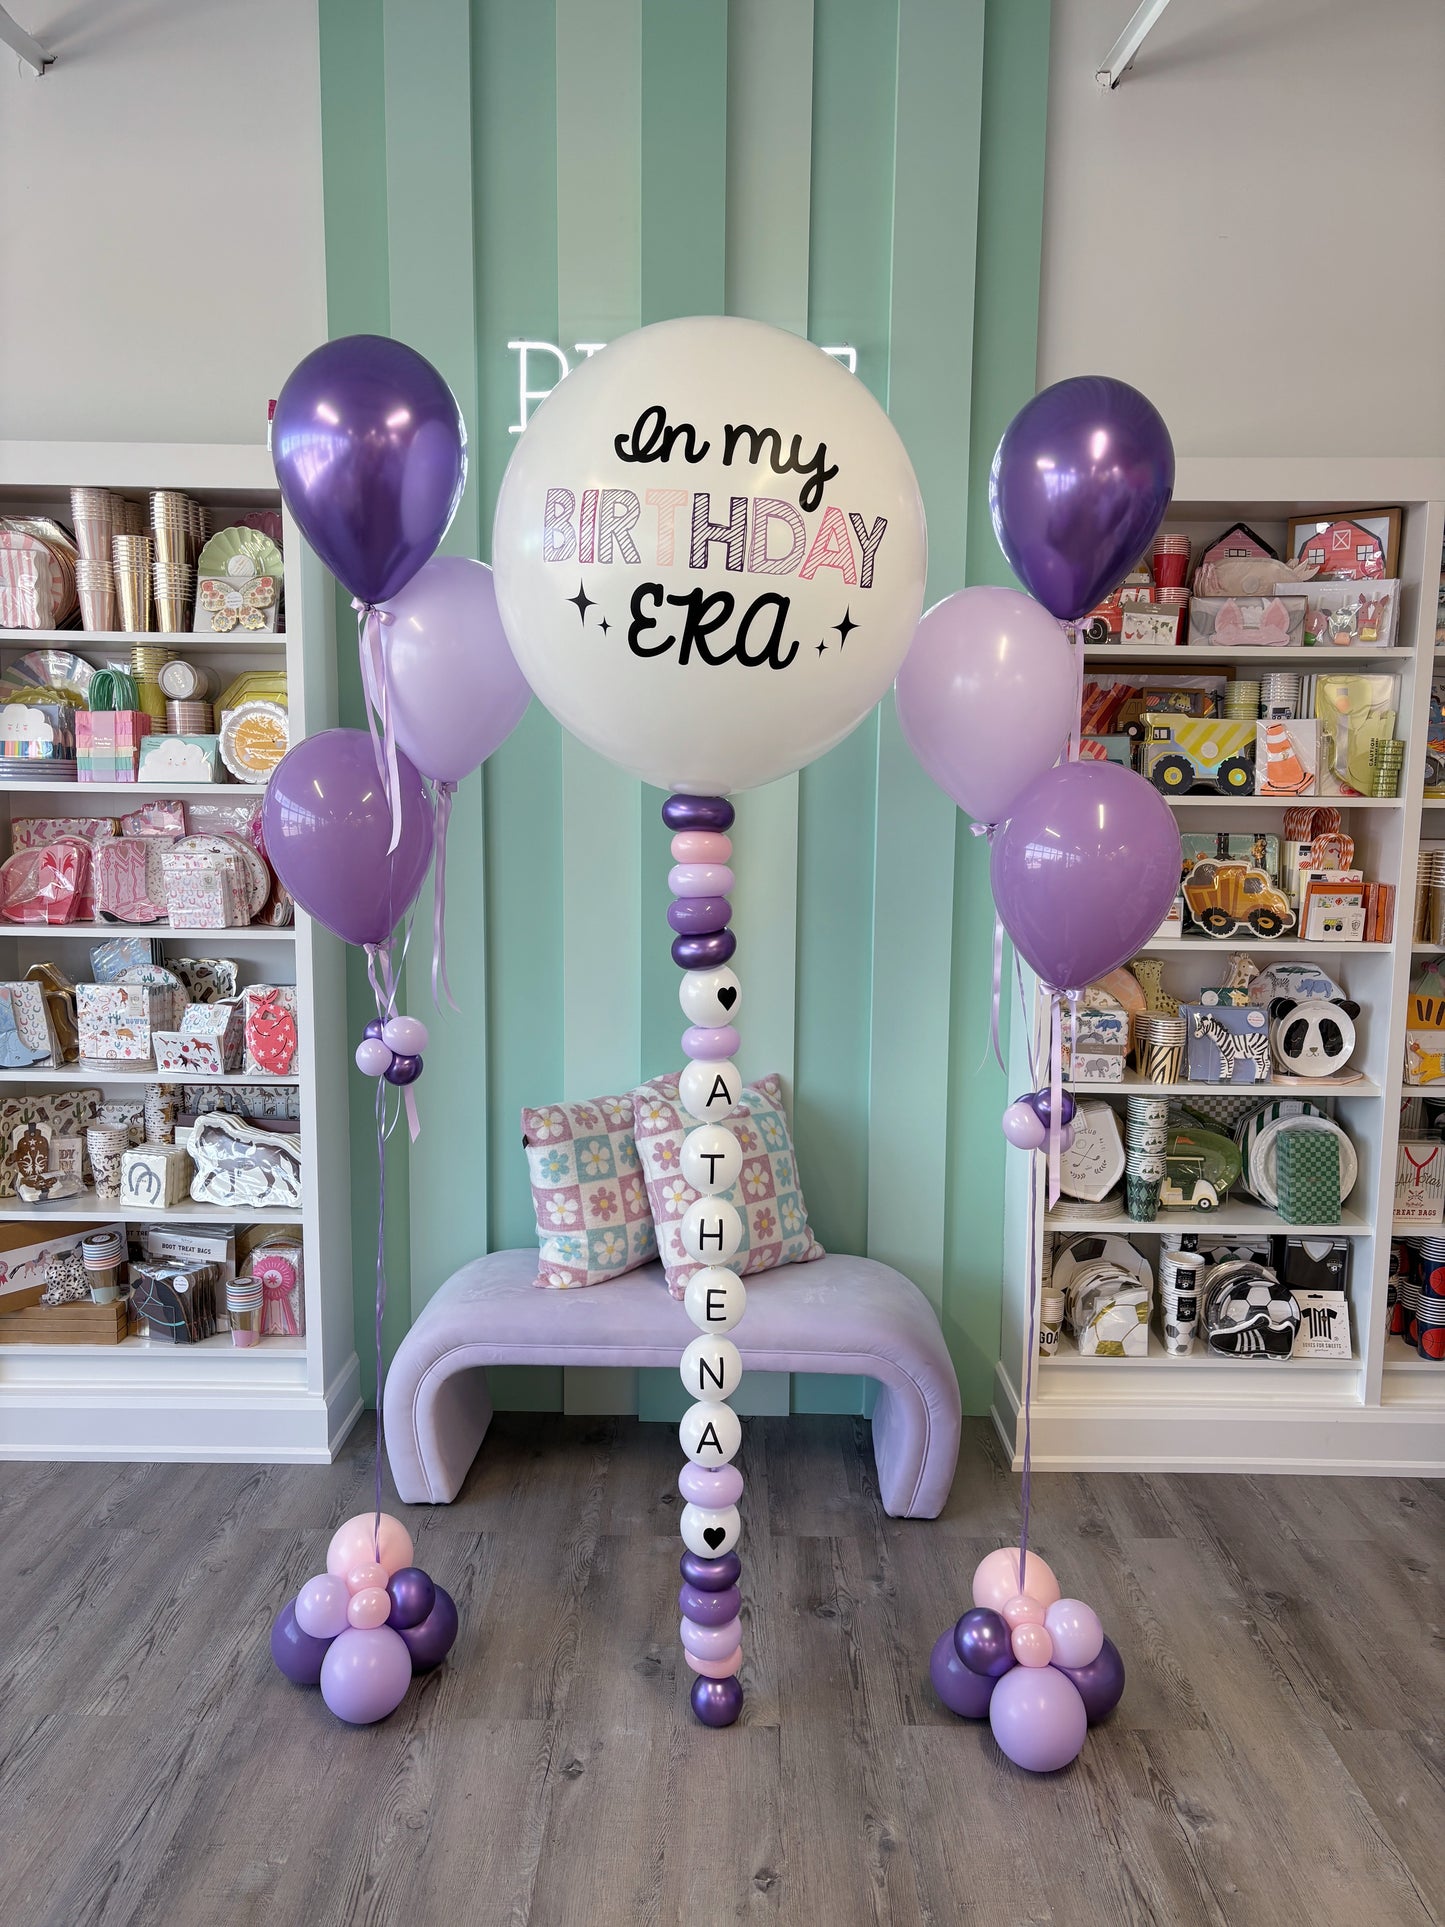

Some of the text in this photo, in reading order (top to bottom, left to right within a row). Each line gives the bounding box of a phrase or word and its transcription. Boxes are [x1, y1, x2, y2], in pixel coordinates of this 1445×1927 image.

[615, 405, 840, 512] In my
[543, 487, 889, 589] BIRTHDAY
[627, 582, 801, 670] ERA
[178, 1245, 196, 1253] TREAT
[197, 1247, 211, 1255] BAGS
[695, 1073, 733, 1455] ATHENA
